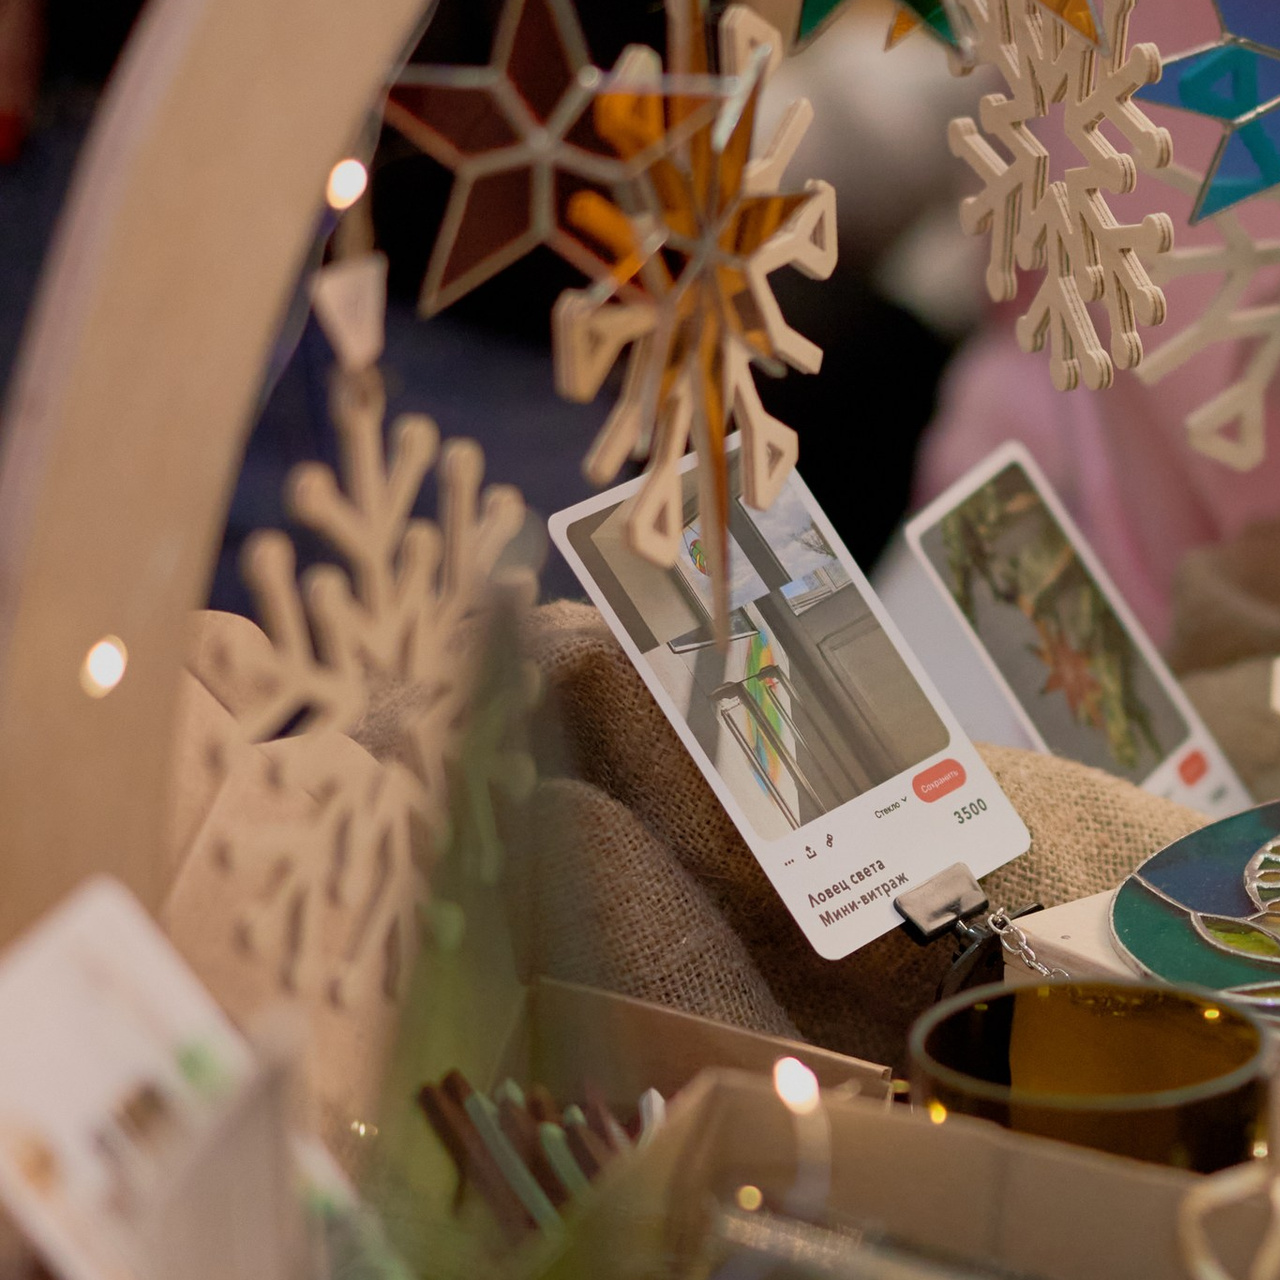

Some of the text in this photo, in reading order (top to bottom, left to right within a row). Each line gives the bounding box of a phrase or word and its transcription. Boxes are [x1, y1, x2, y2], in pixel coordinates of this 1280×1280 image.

[920, 769, 959, 794] Сохранить
[874, 801, 901, 819] Стекло
[953, 798, 988, 824] 3500
[807, 859, 886, 909] Ловец света
[818, 872, 910, 928] Мини-витраж
